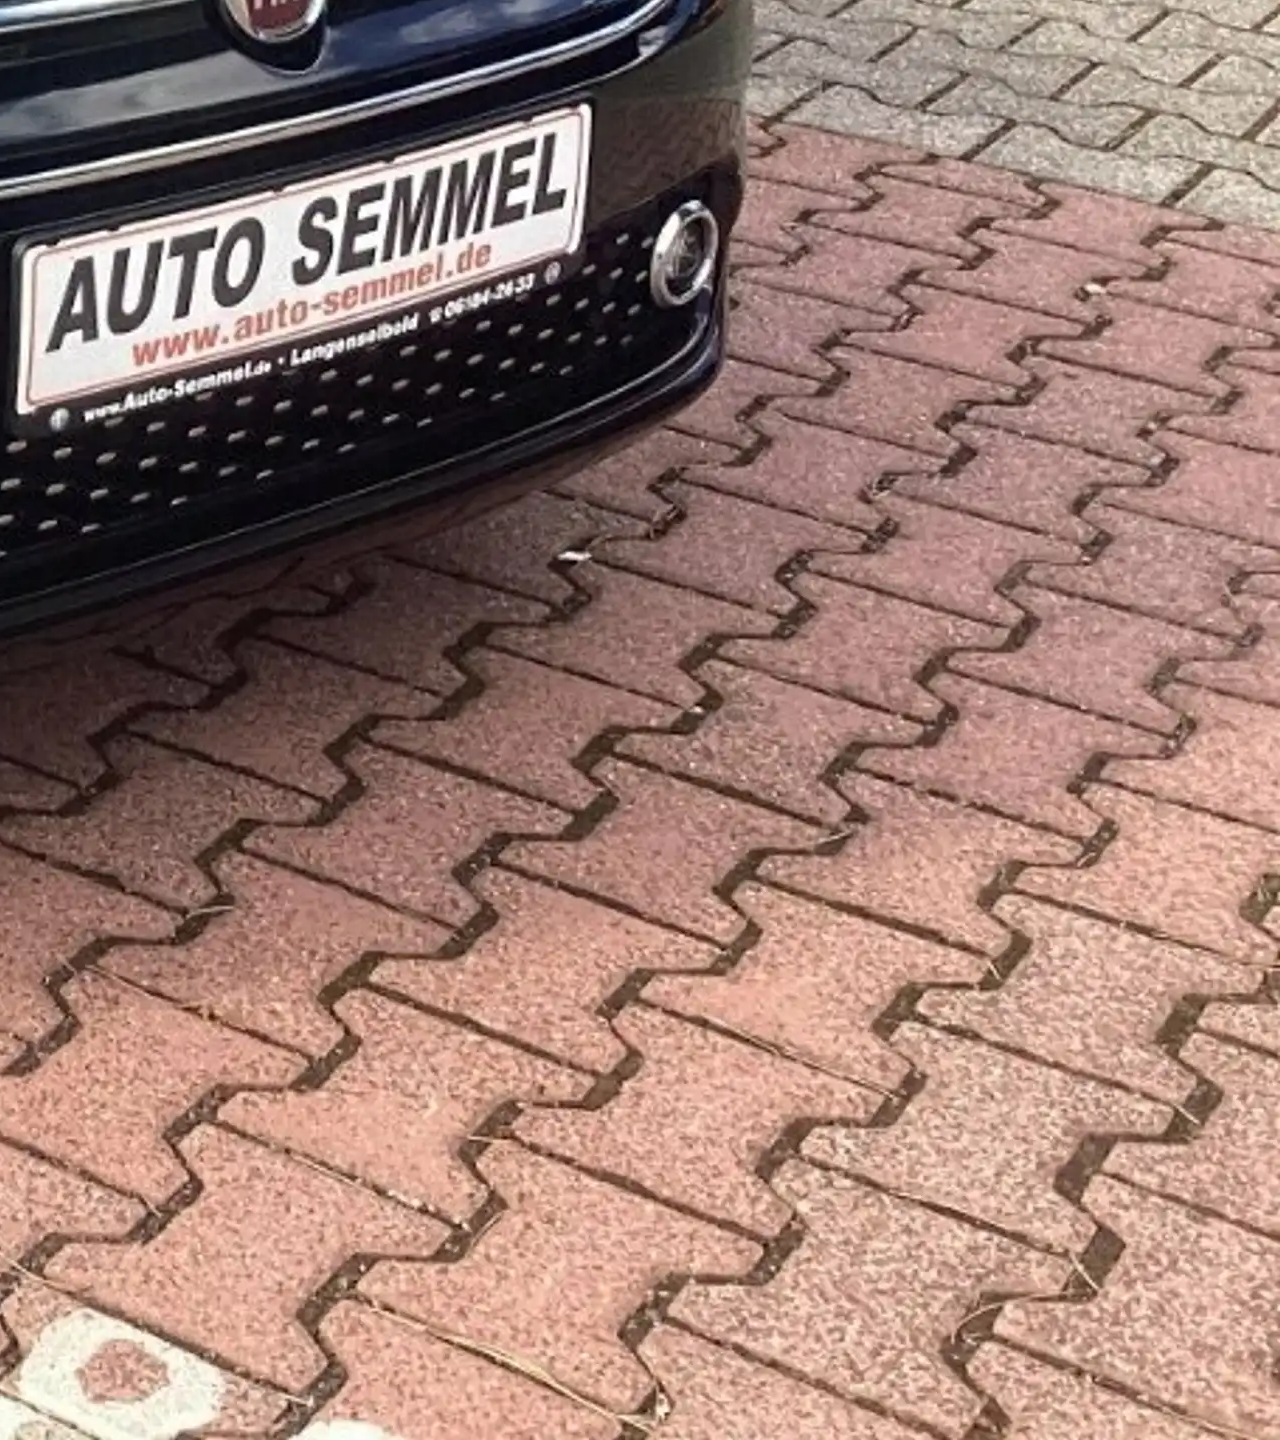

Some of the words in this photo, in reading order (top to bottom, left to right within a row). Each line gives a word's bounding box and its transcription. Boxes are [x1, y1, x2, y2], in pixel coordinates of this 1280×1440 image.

[45, 218, 265, 353] AUTO
[291, 132, 567, 286] SEMMEL
[132, 241, 492, 366] www.auto-semmel.de
